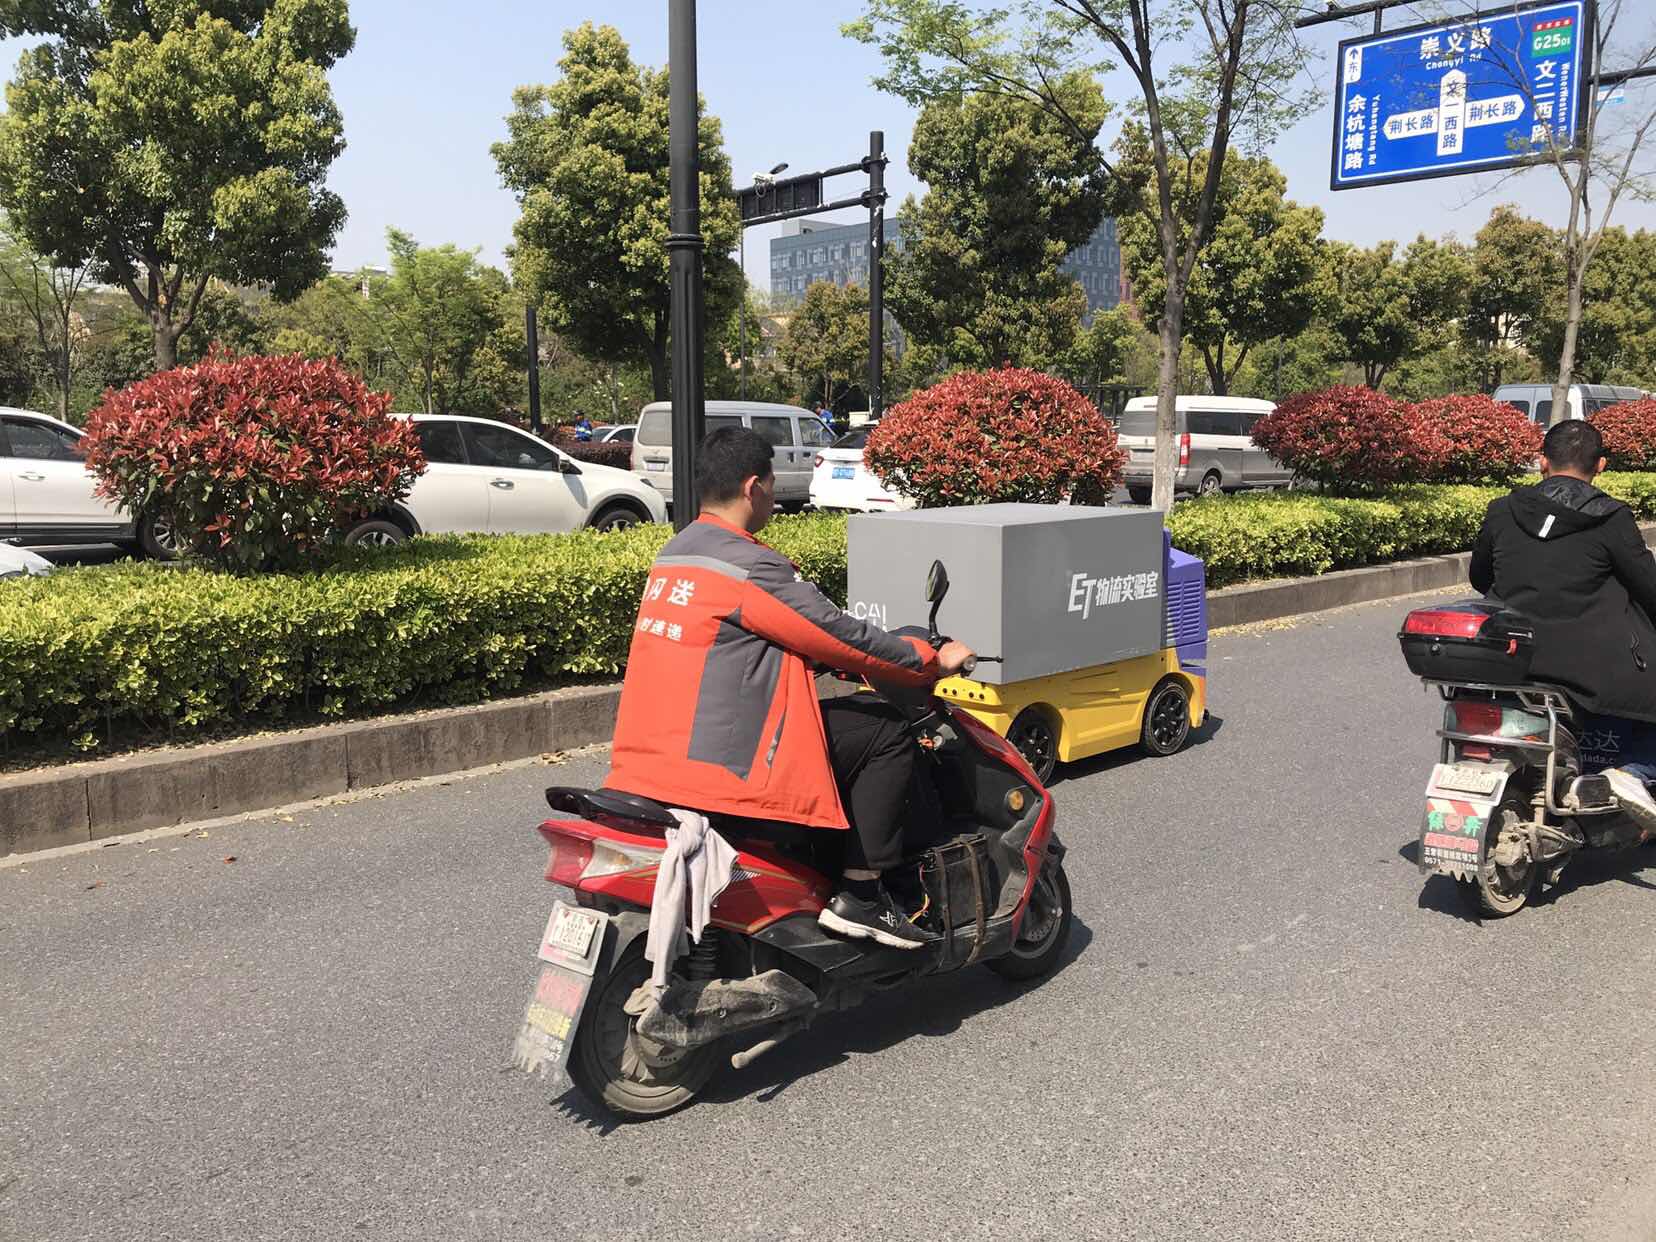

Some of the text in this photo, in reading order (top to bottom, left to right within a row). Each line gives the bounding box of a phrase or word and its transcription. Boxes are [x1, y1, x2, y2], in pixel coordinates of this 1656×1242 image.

[1419, 27, 1492, 60] 崇义路
[1534, 34, 1570, 51] G2501
[1442, 79, 1460, 149] 文一西路
[1470, 100, 1517, 121] 荆长路
[1344, 93, 1367, 170] 余杭塘路
[1389, 114, 1434, 135] 荆长路
